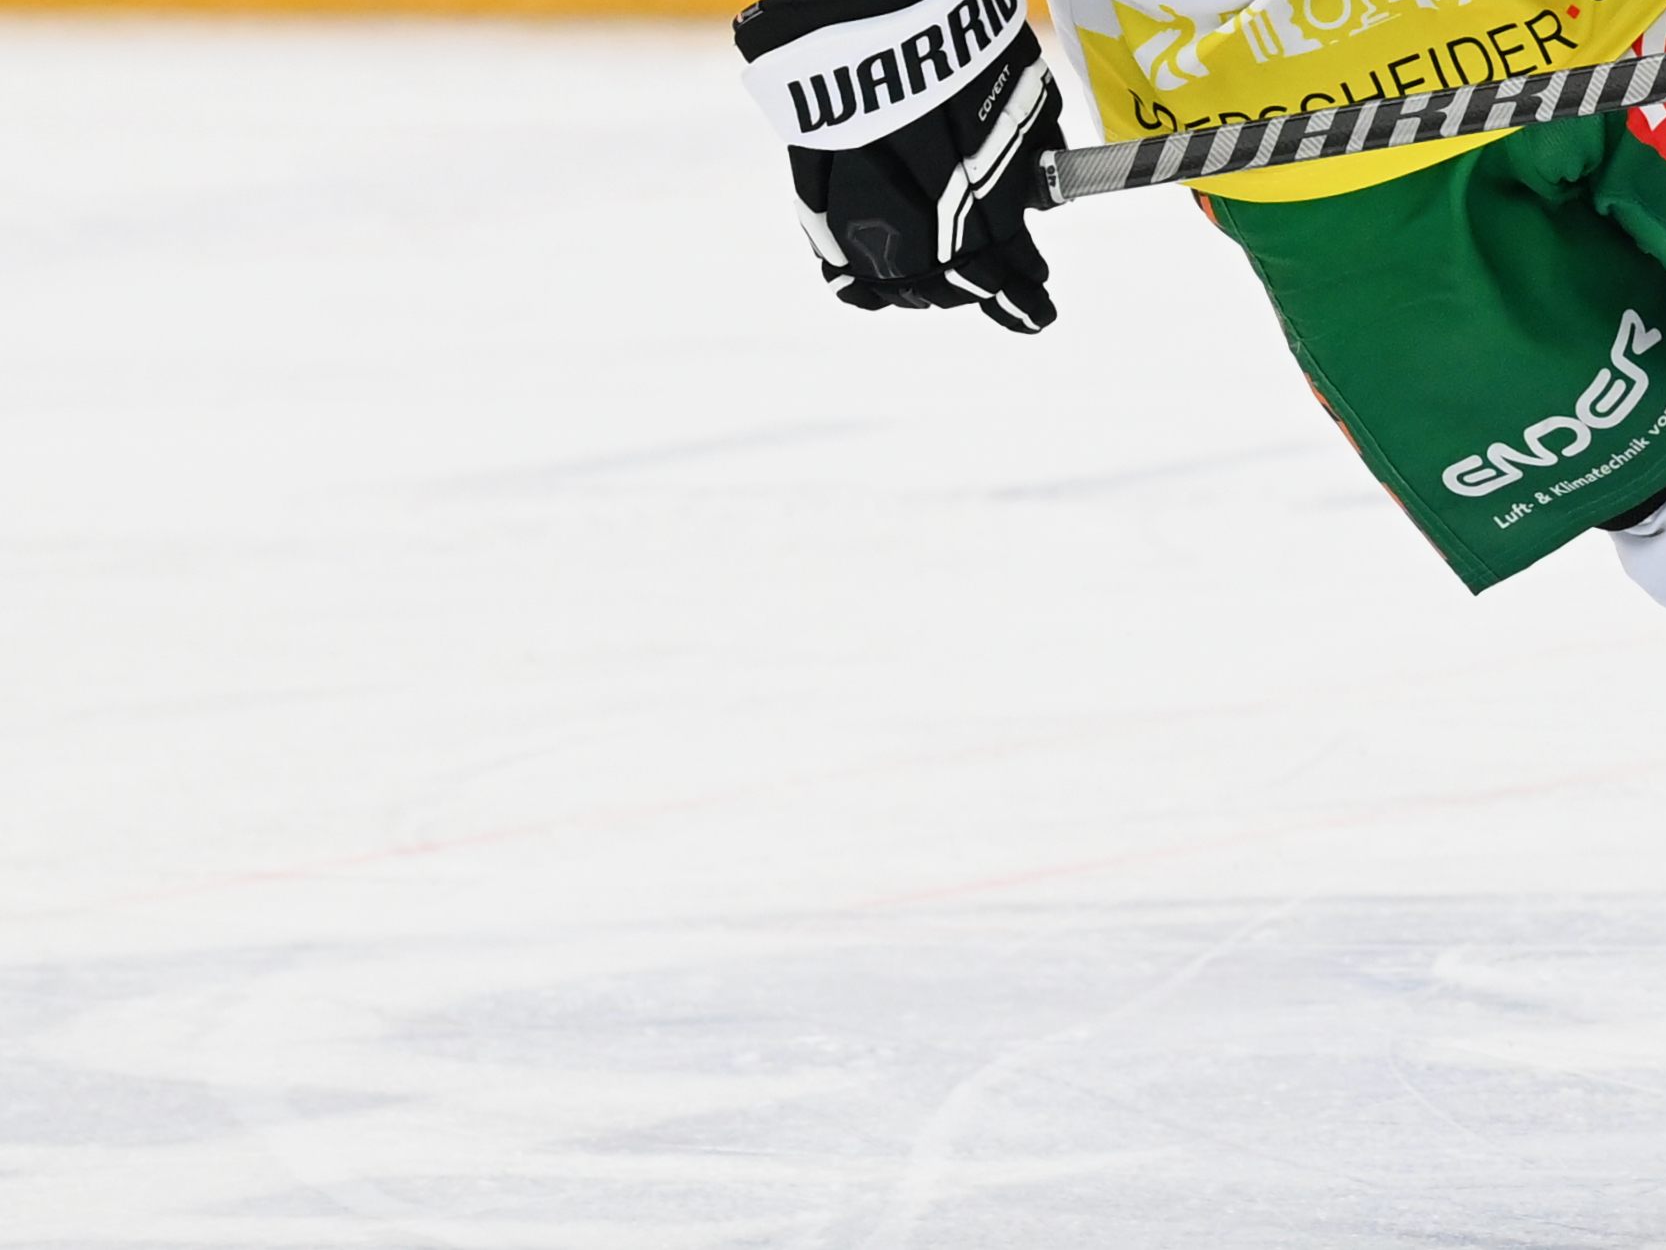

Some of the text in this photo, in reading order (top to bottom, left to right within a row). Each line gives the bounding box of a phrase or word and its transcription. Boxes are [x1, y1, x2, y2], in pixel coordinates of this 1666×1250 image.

[978, 64, 1010, 122] COVERT
[1442, 309, 1662, 497] ENDER
[1493, 502, 1534, 529] Luft-
[1534, 490, 1553, 506] &
[1550, 436, 1650, 497] Klimatechnik
